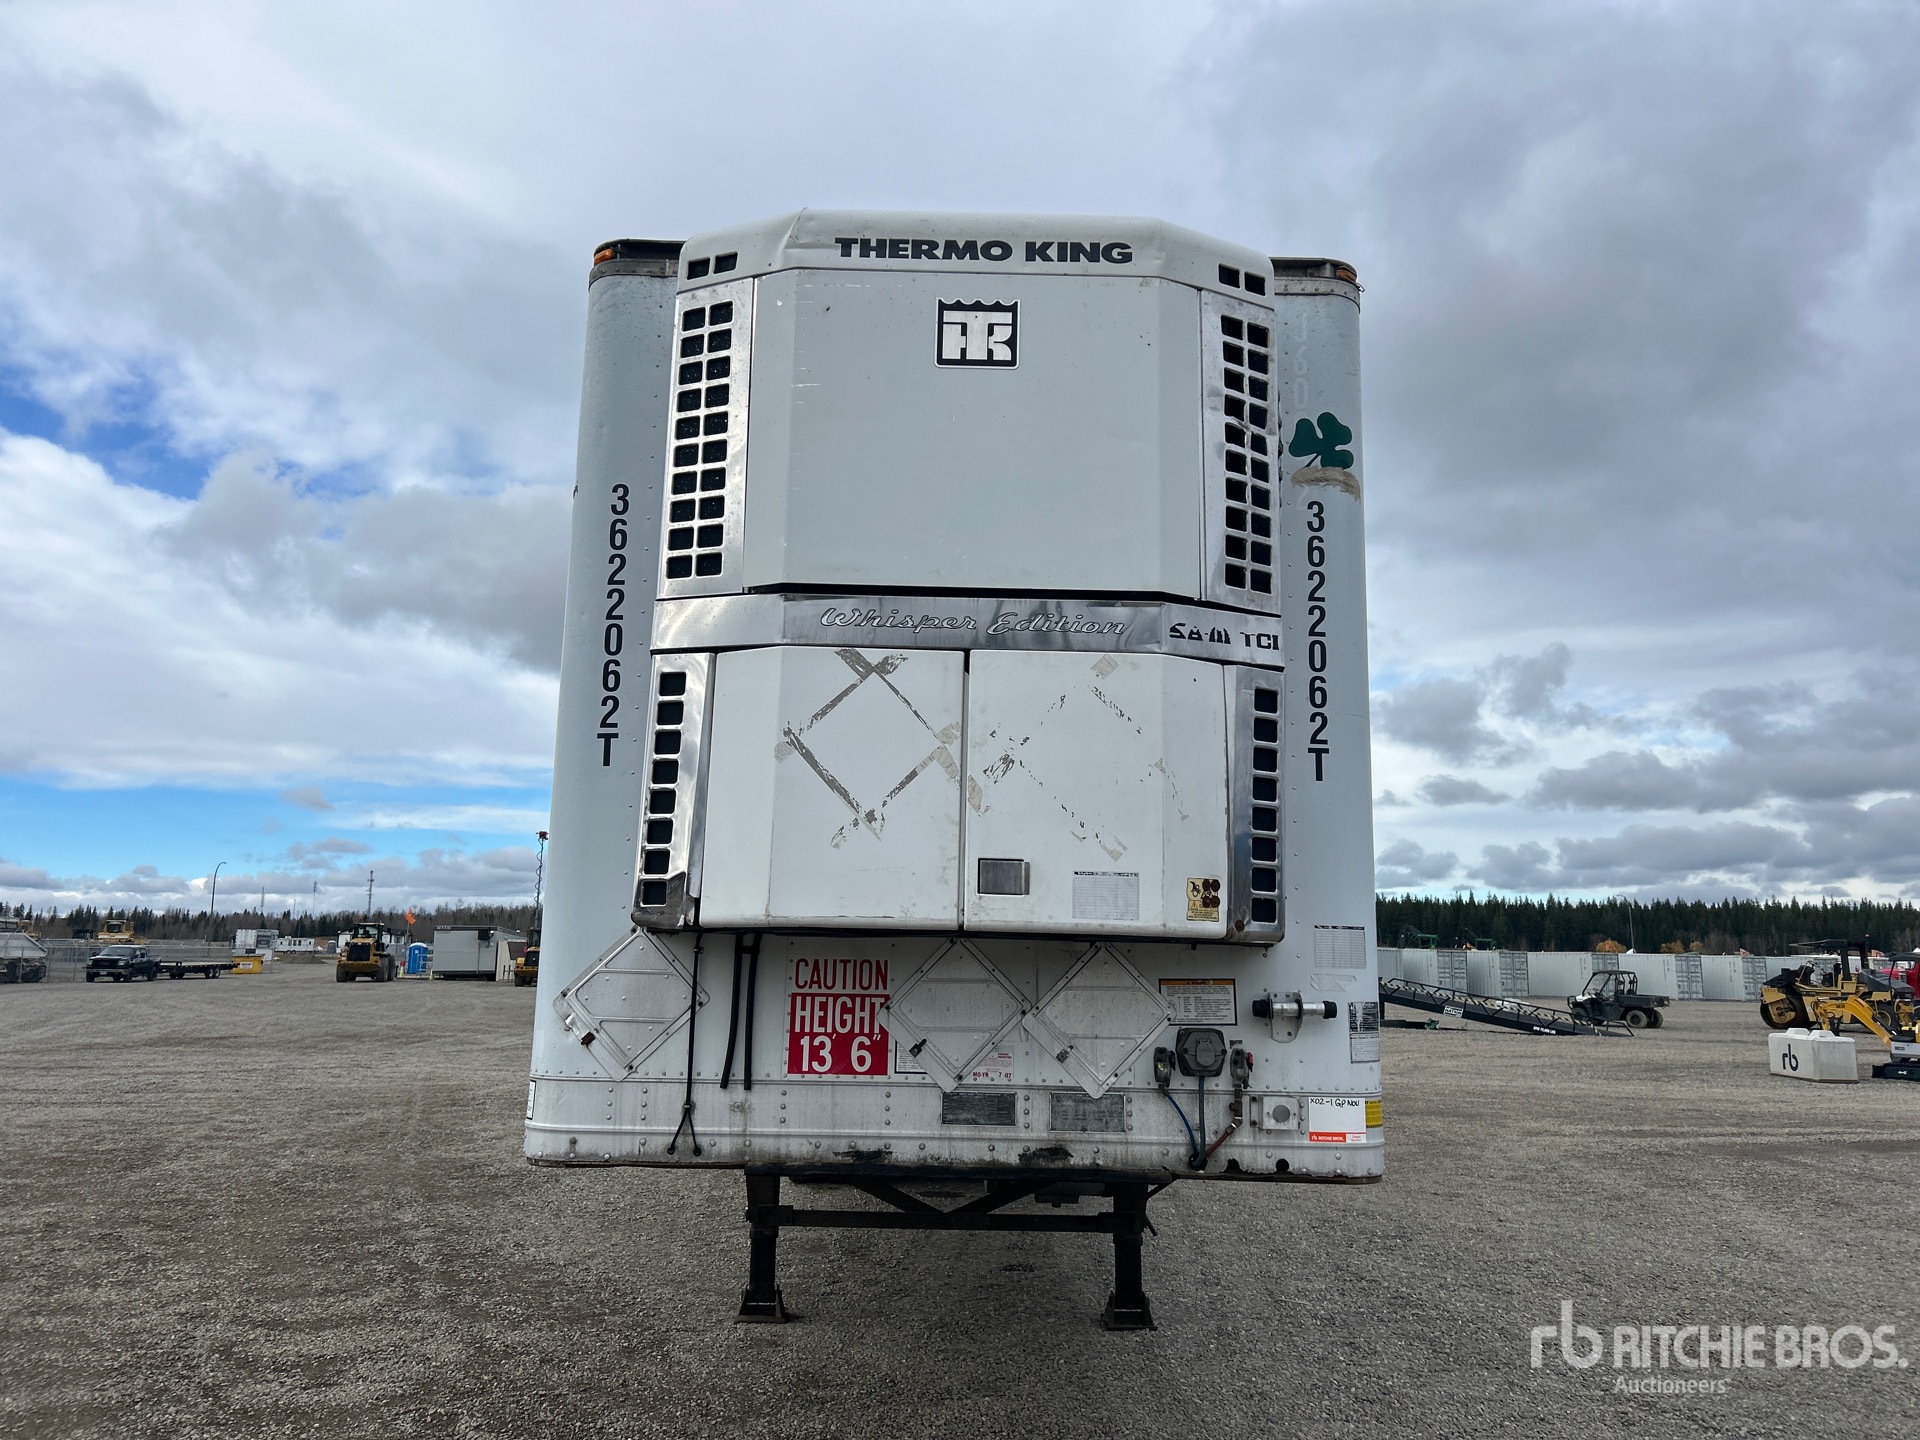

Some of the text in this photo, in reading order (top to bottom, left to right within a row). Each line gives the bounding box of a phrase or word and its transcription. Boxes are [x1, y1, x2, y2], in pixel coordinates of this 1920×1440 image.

[835, 238, 1132, 264] THERMO KING
[597, 484, 629, 766] 3622062T
[820, 607, 1125, 636] Whisper Edition
[1240, 632, 1279, 650] TCI
[1306, 501, 1329, 782] 3622062T
[795, 958, 888, 990] CAUTION
[795, 996, 885, 1033] HEIGHT
[1782, 1043, 1799, 1071] rb
